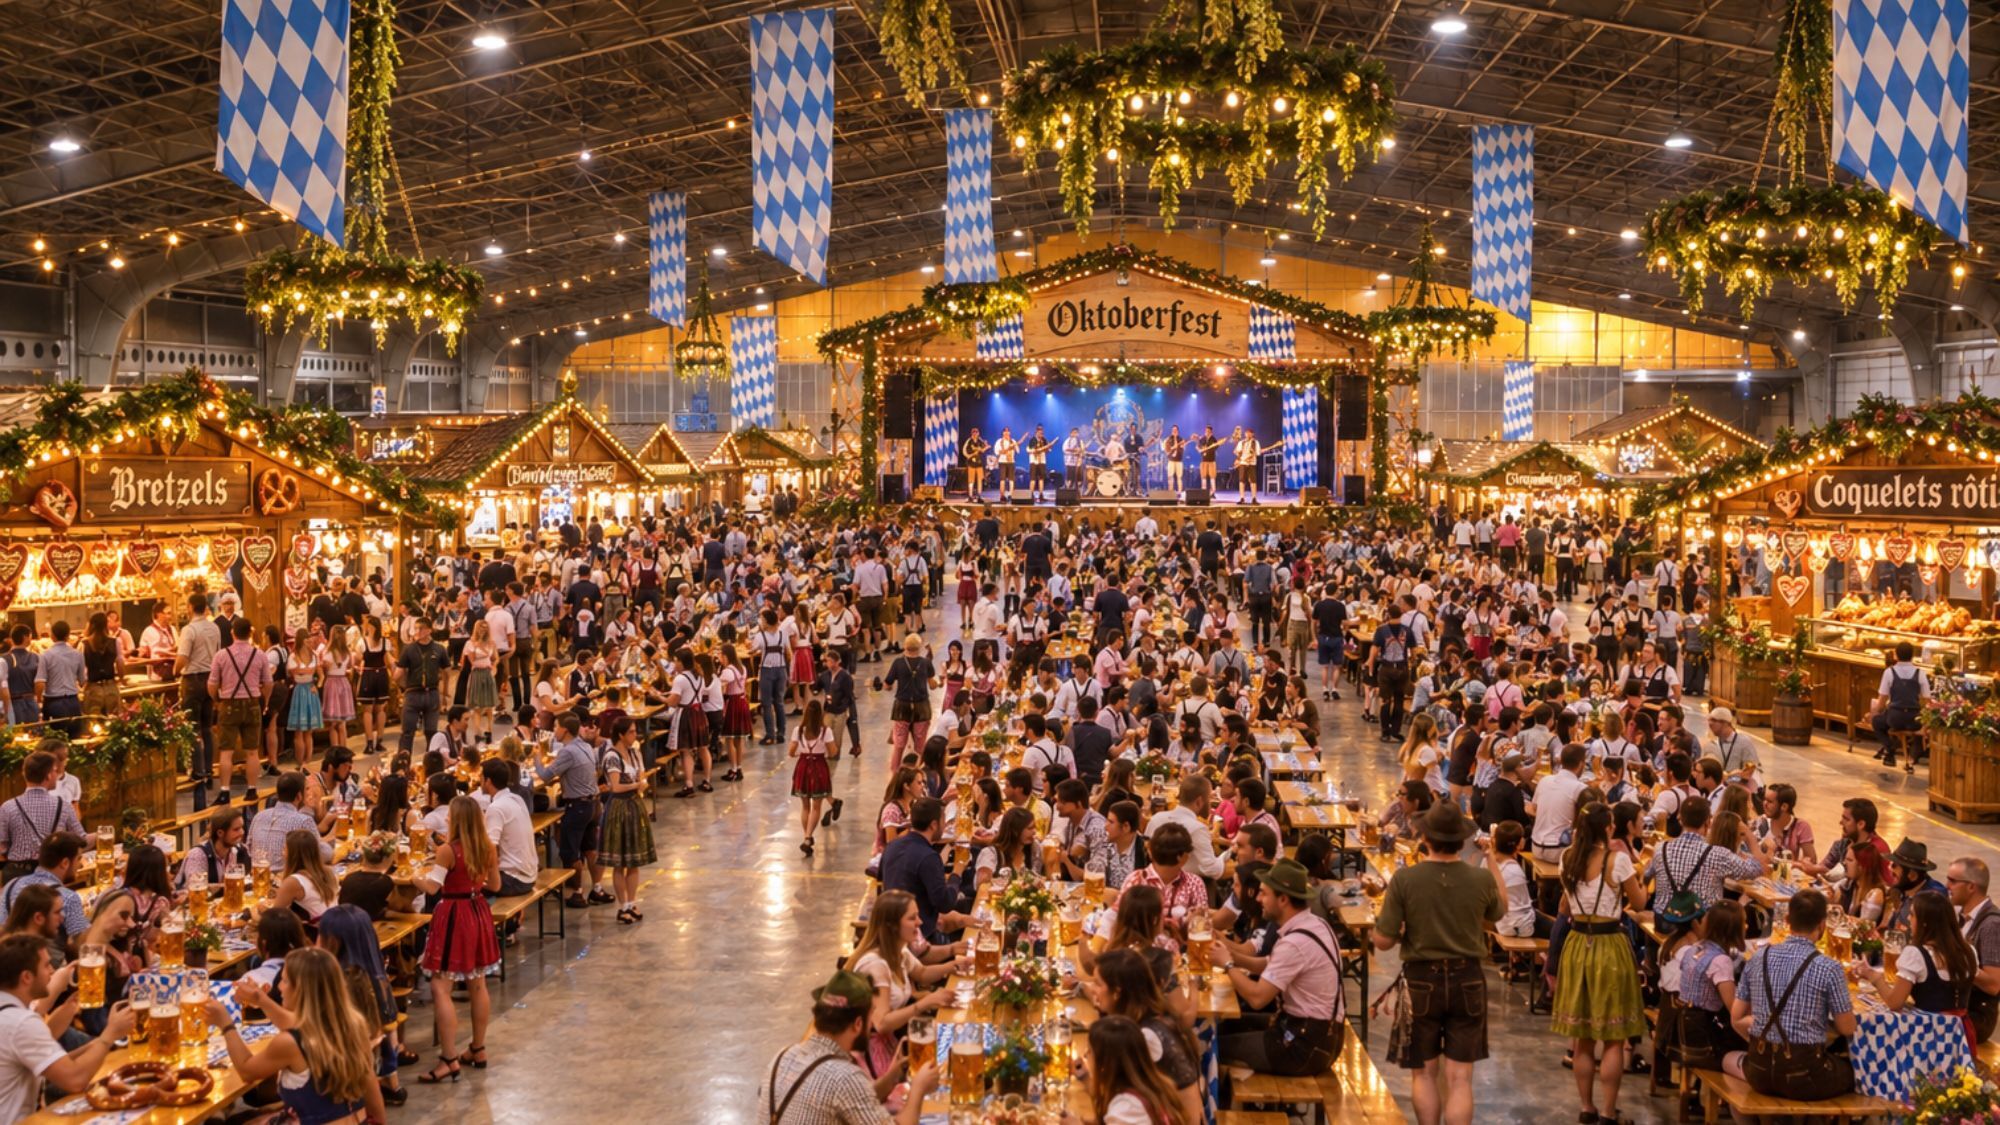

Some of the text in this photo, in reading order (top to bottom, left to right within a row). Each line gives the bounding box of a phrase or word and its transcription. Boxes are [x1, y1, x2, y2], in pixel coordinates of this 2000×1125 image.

[1047, 297, 1222, 338] Oktoberfest
[109, 465, 229, 511] Bretzels
[1814, 474, 2000, 515] Coquelets rôti
